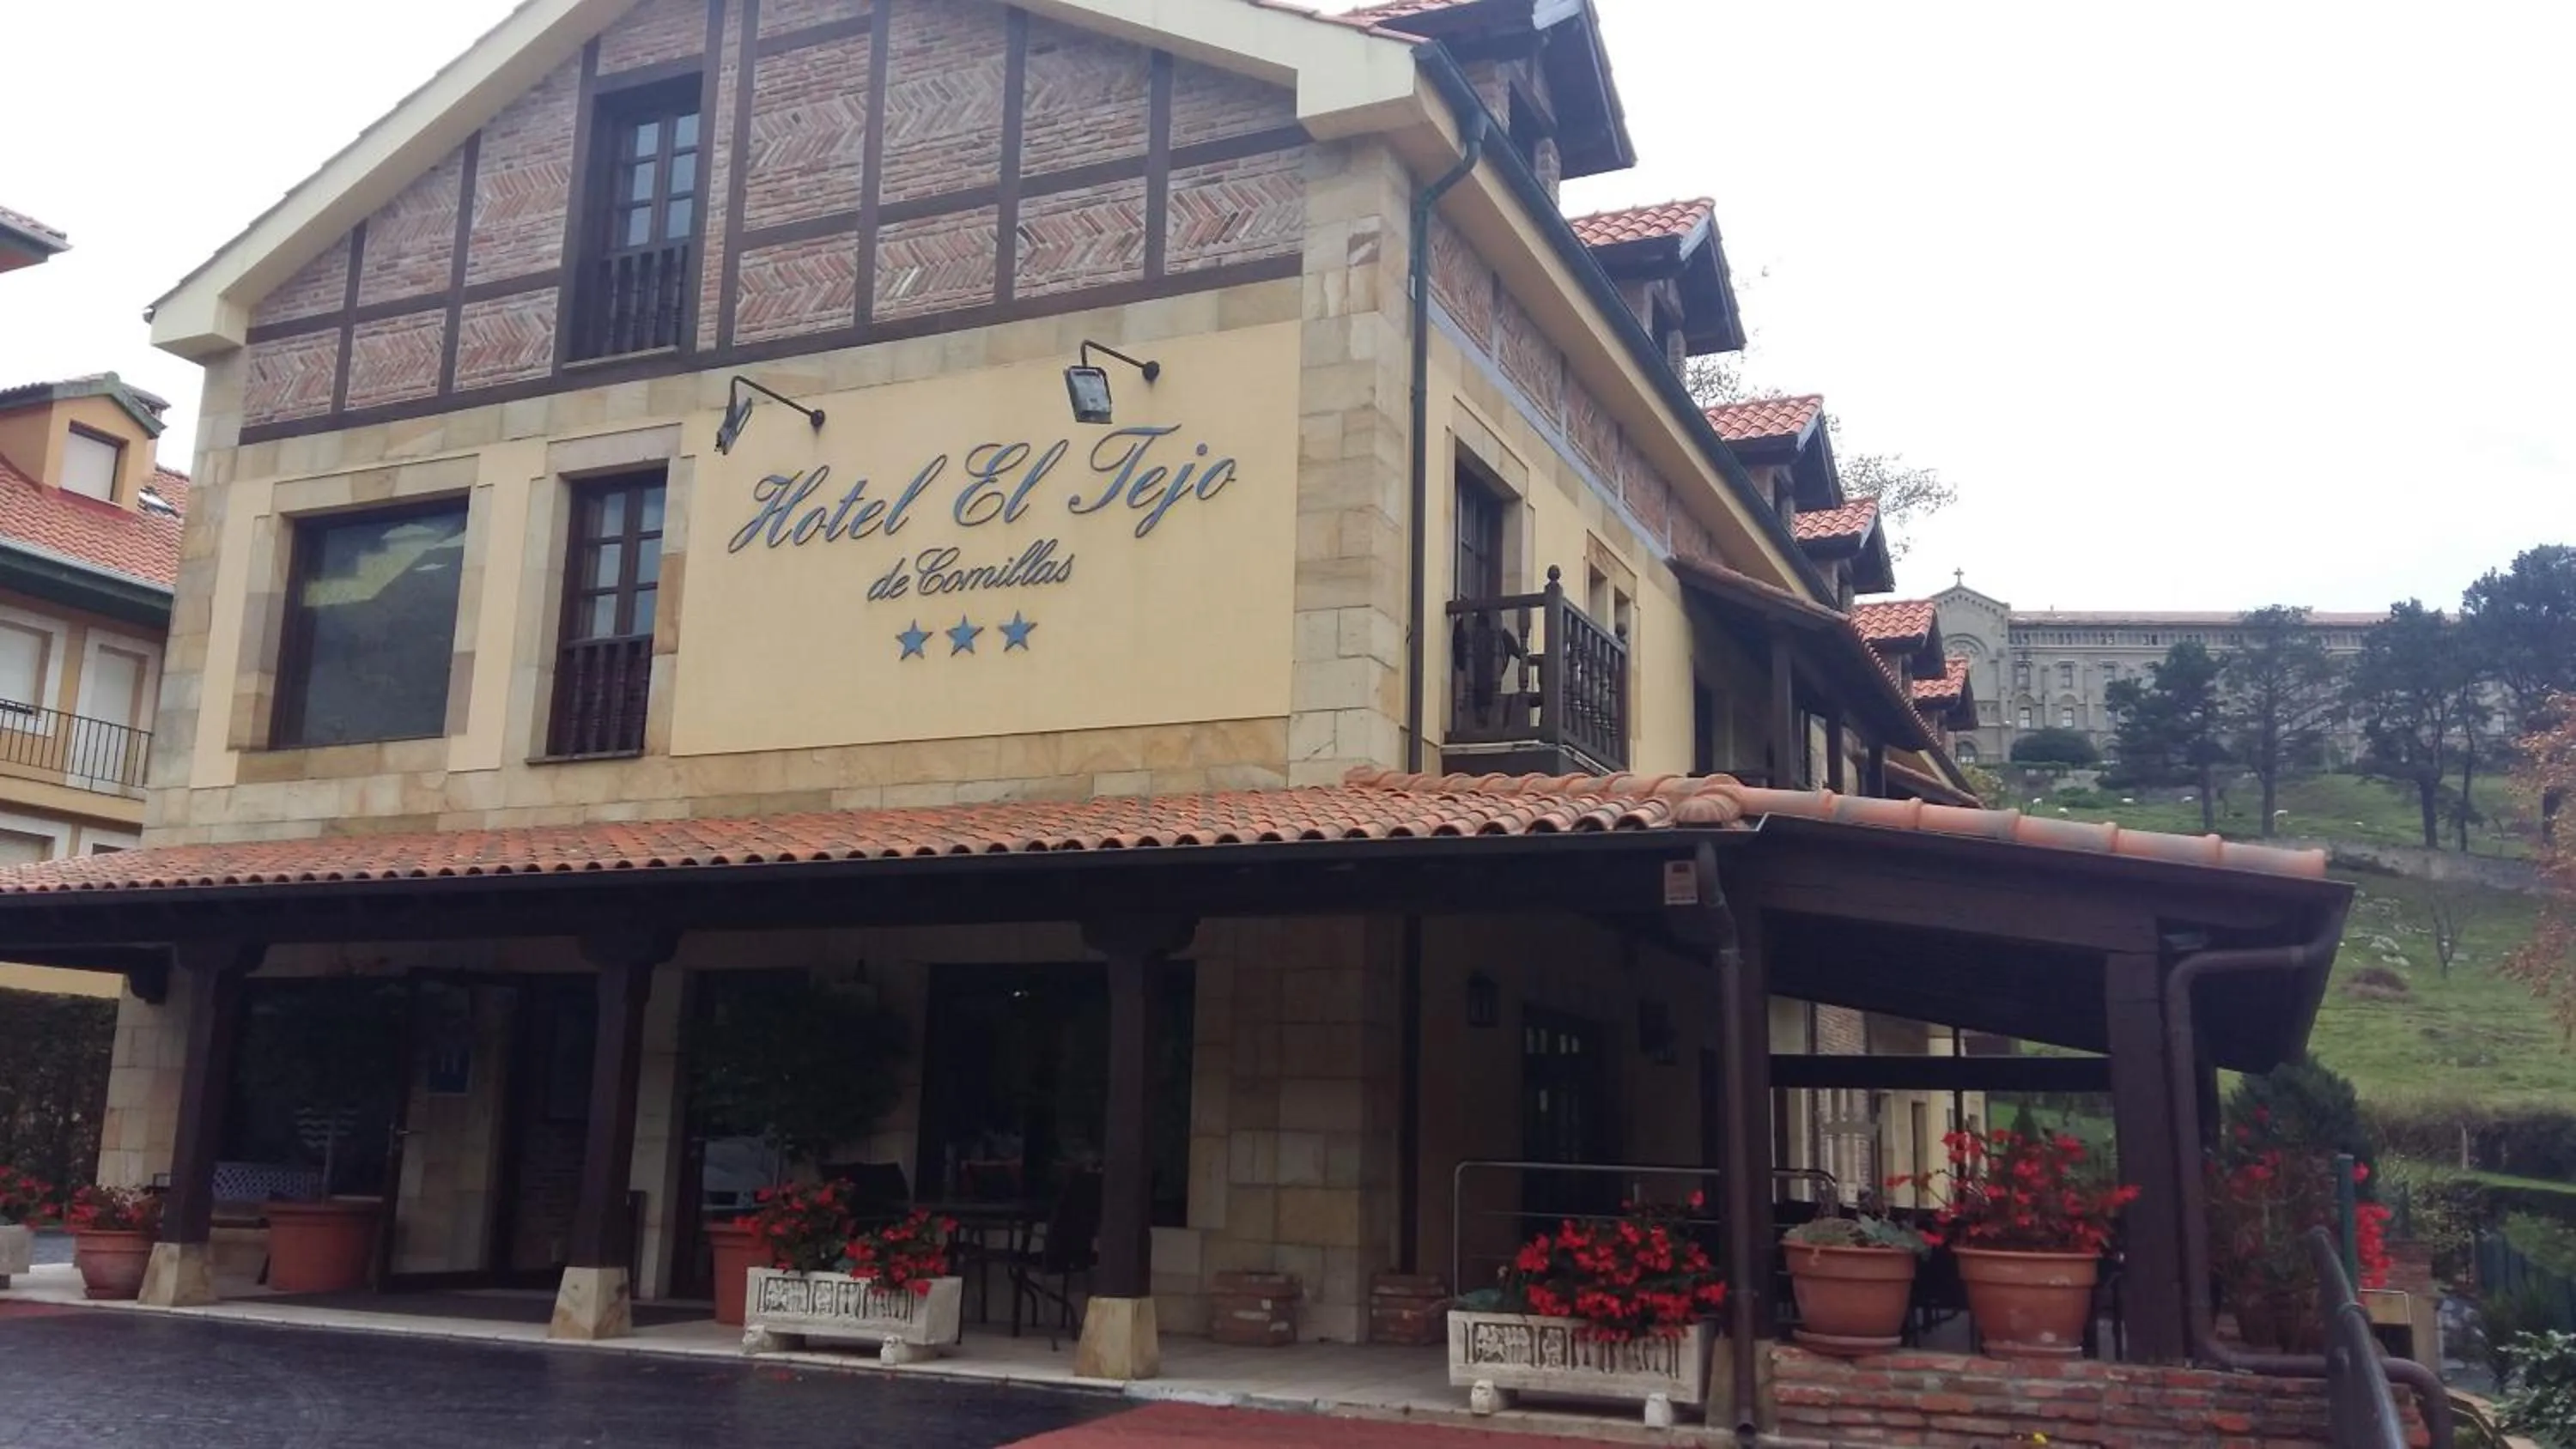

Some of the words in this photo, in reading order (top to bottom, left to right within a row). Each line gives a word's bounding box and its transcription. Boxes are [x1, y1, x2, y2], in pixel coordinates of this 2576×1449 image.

[728, 454, 947, 554] Hotel
[953, 439, 1070, 527] El
[1068, 423, 1237, 538] Tejo
[867, 558, 908, 603] de
[914, 538, 1076, 597] Comillas
